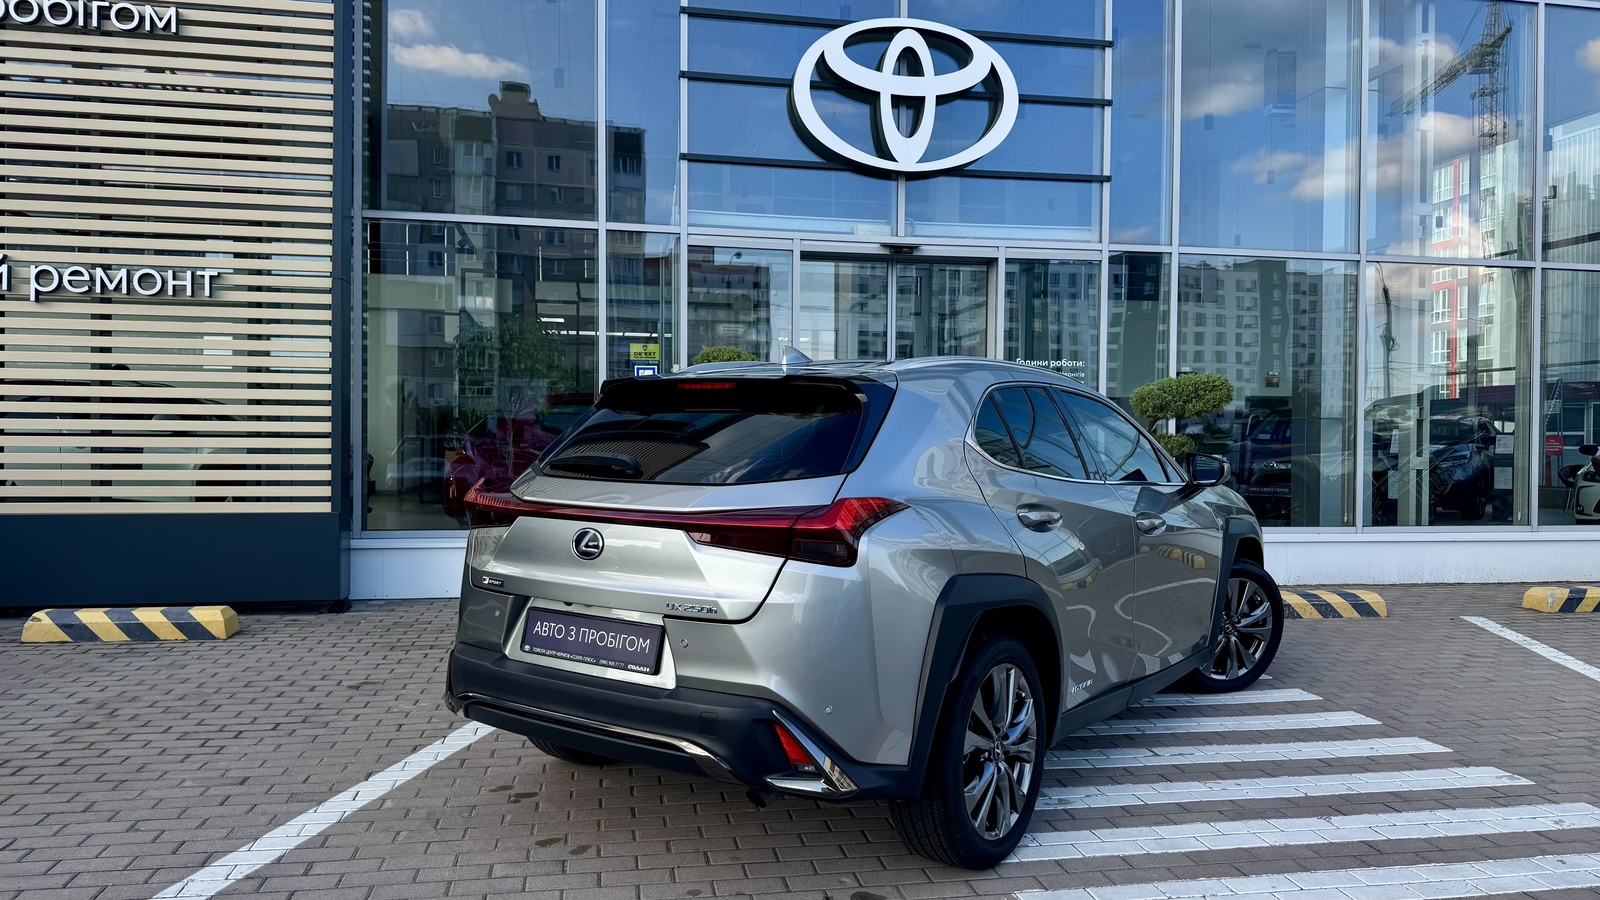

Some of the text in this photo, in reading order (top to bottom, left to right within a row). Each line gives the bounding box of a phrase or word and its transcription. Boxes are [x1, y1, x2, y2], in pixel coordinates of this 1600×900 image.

[0, 0, 179, 33] обігом
[30, 264, 219, 302] ремонт
[1050, 358, 1085, 369] роботи:
[684, 603, 718, 614] 250h
[533, 621, 565, 639] АВТО
[578, 628, 651, 654] ПРОБІГОМ
